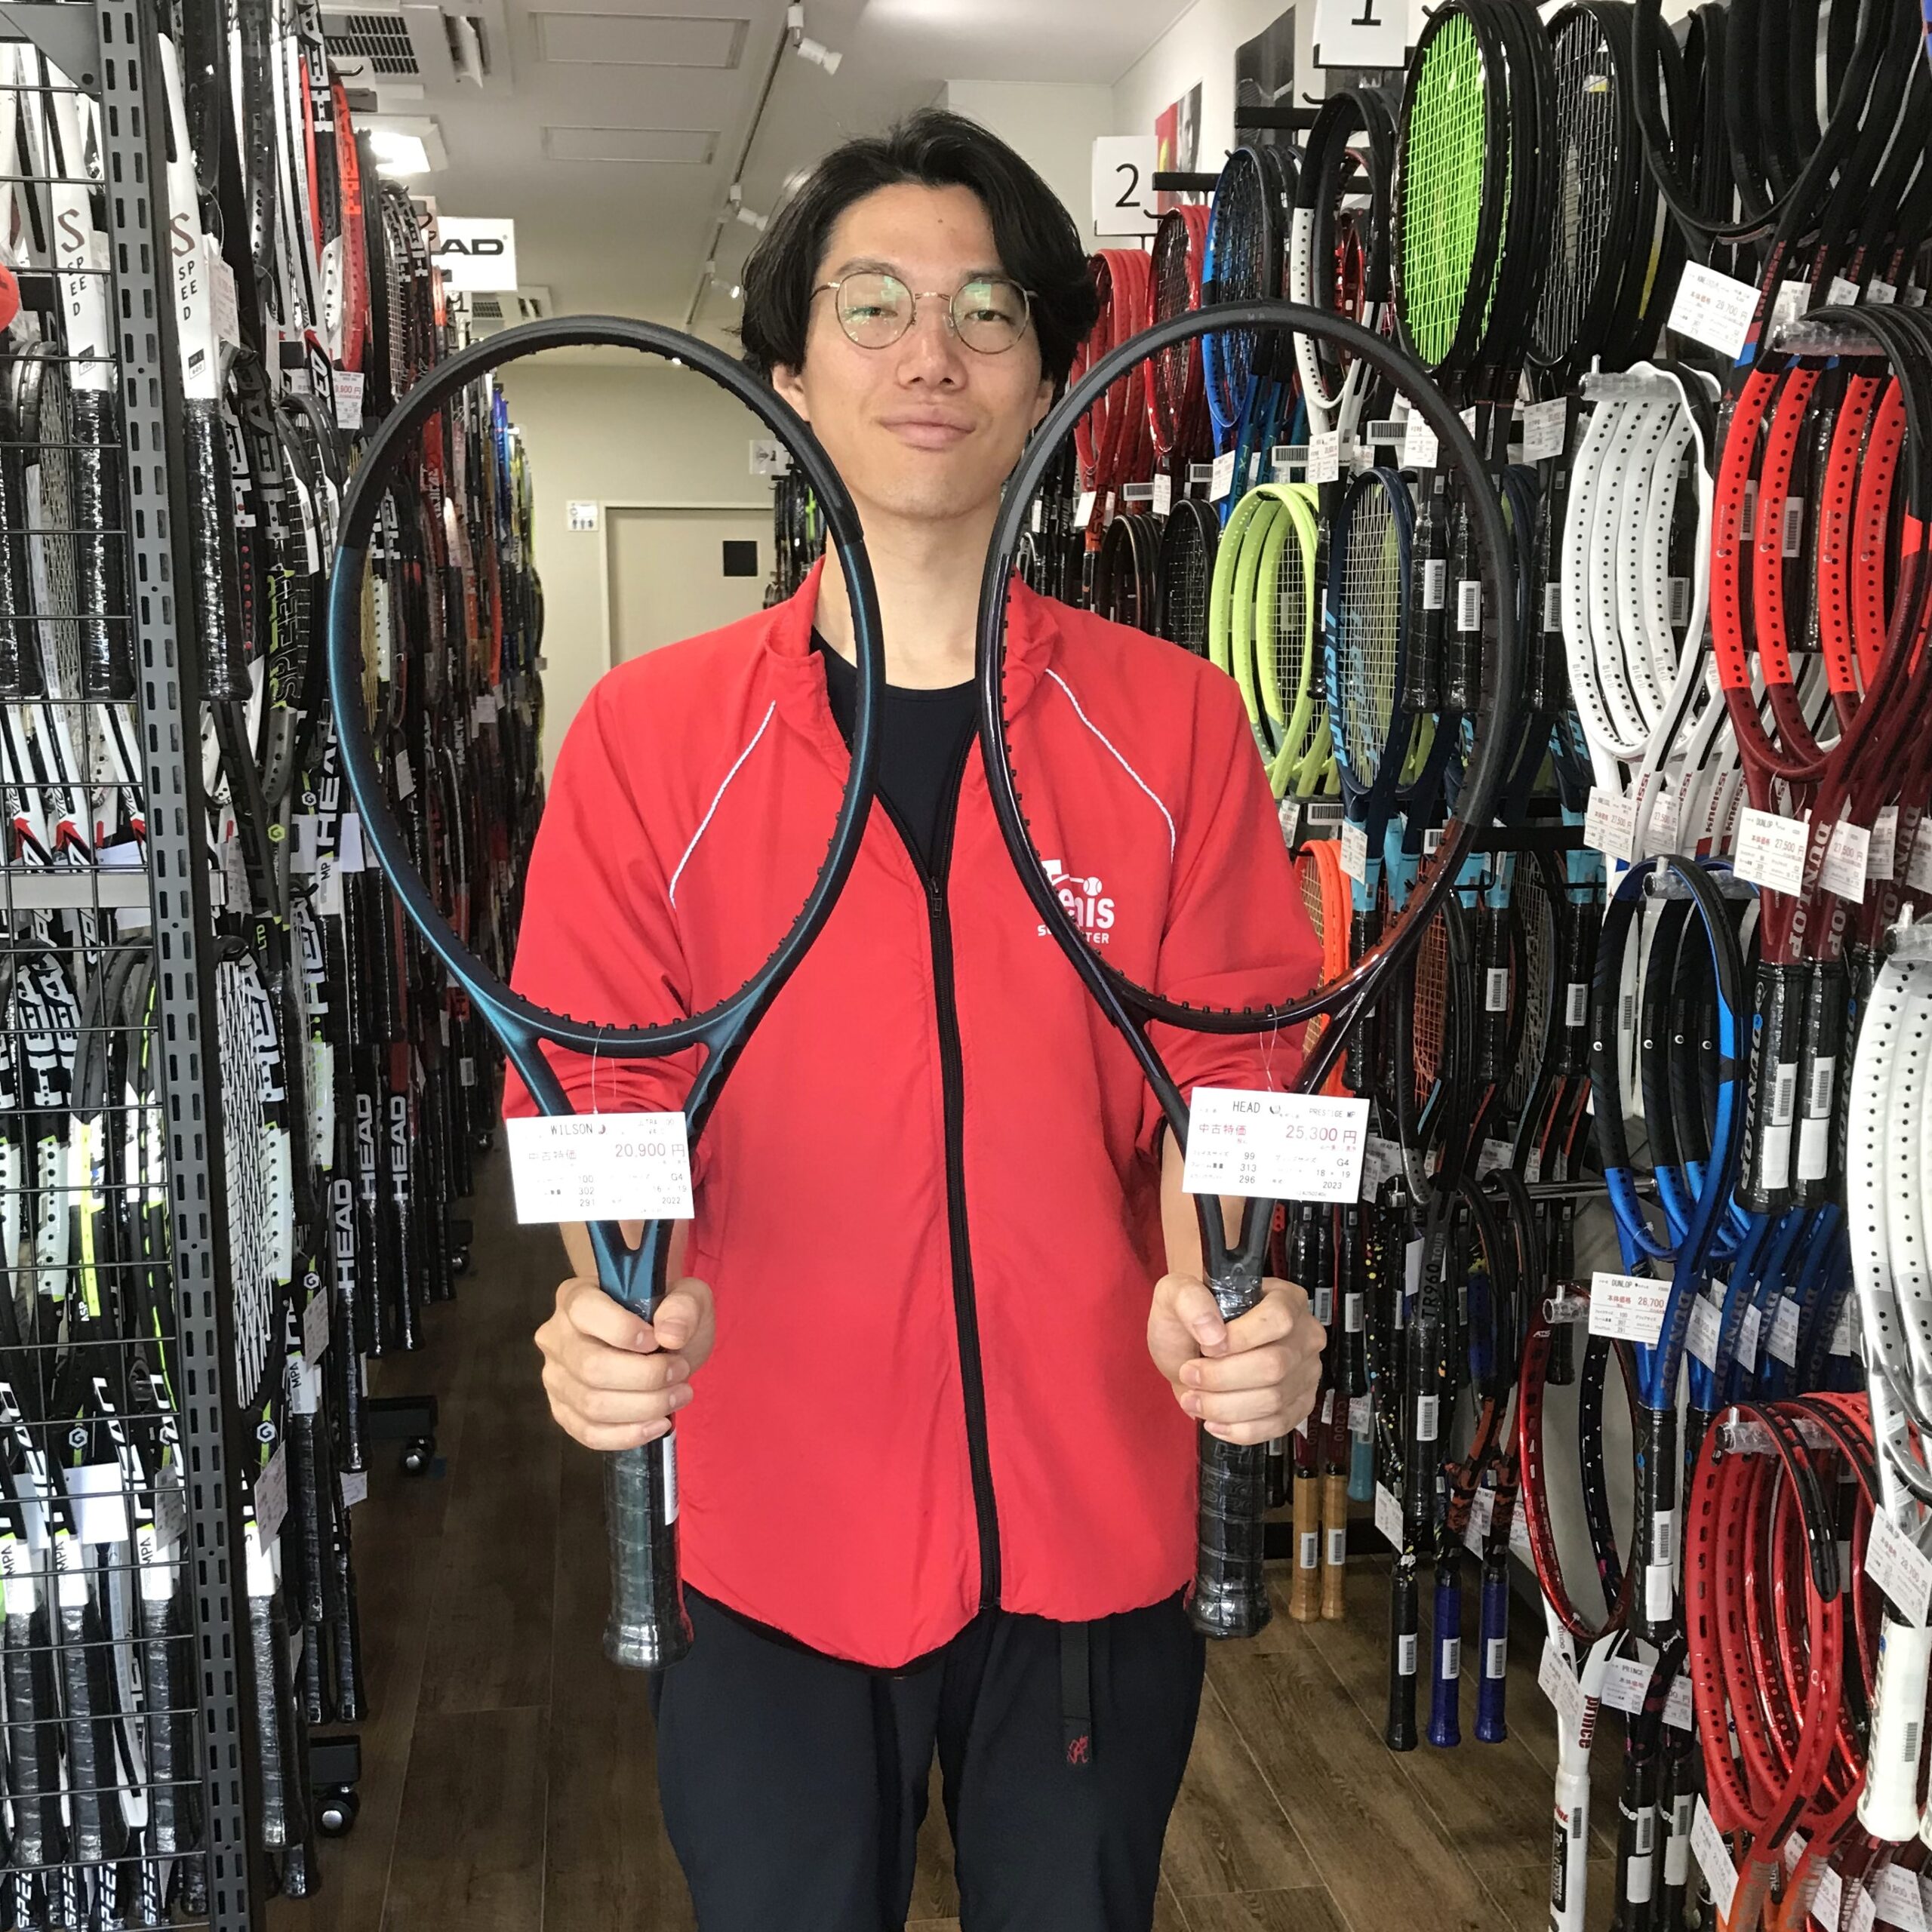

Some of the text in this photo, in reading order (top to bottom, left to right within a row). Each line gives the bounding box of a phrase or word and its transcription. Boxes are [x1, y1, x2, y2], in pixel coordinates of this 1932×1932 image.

[1115, 164, 1140, 208] 2
[57, 208, 85, 253] S
[169, 212, 195, 257] S
[431, 238, 504, 255] AD
[1774, 838, 1796, 854] 27,500
[255, 923, 269, 952] LTD
[1233, 1101, 1260, 1114] HEAD
[550, 1124, 593, 1135] WILSON
[1198, 1123, 1358, 1144] 中古特価 25,300 円
[356, 1094, 377, 1201] HEAD
[390, 1096, 408, 1201] HEAD
[671, 1143, 686, 1158] 円
[1244, 1152, 1256, 1161] 99
[1336, 1158, 1350, 1168] G4
[1239, 1163, 1257, 1173] 313
[1316, 1169, 1326, 1177] 18
[1341, 1171, 1351, 1179] 19
[670, 1173, 684, 1182] G4
[1238, 1175, 1257, 1185] 296
[578, 1186, 595, 1196] 302
[1322, 1181, 1343, 1190] 2023
[661, 1196, 681, 1205] 2022
[334, 1178, 355, 1290] HEAD
[1421, 1263, 1441, 1320] TR960
[1638, 1297, 1665, 1309] 28,700
[1578, 1694, 1600, 1749] prince
